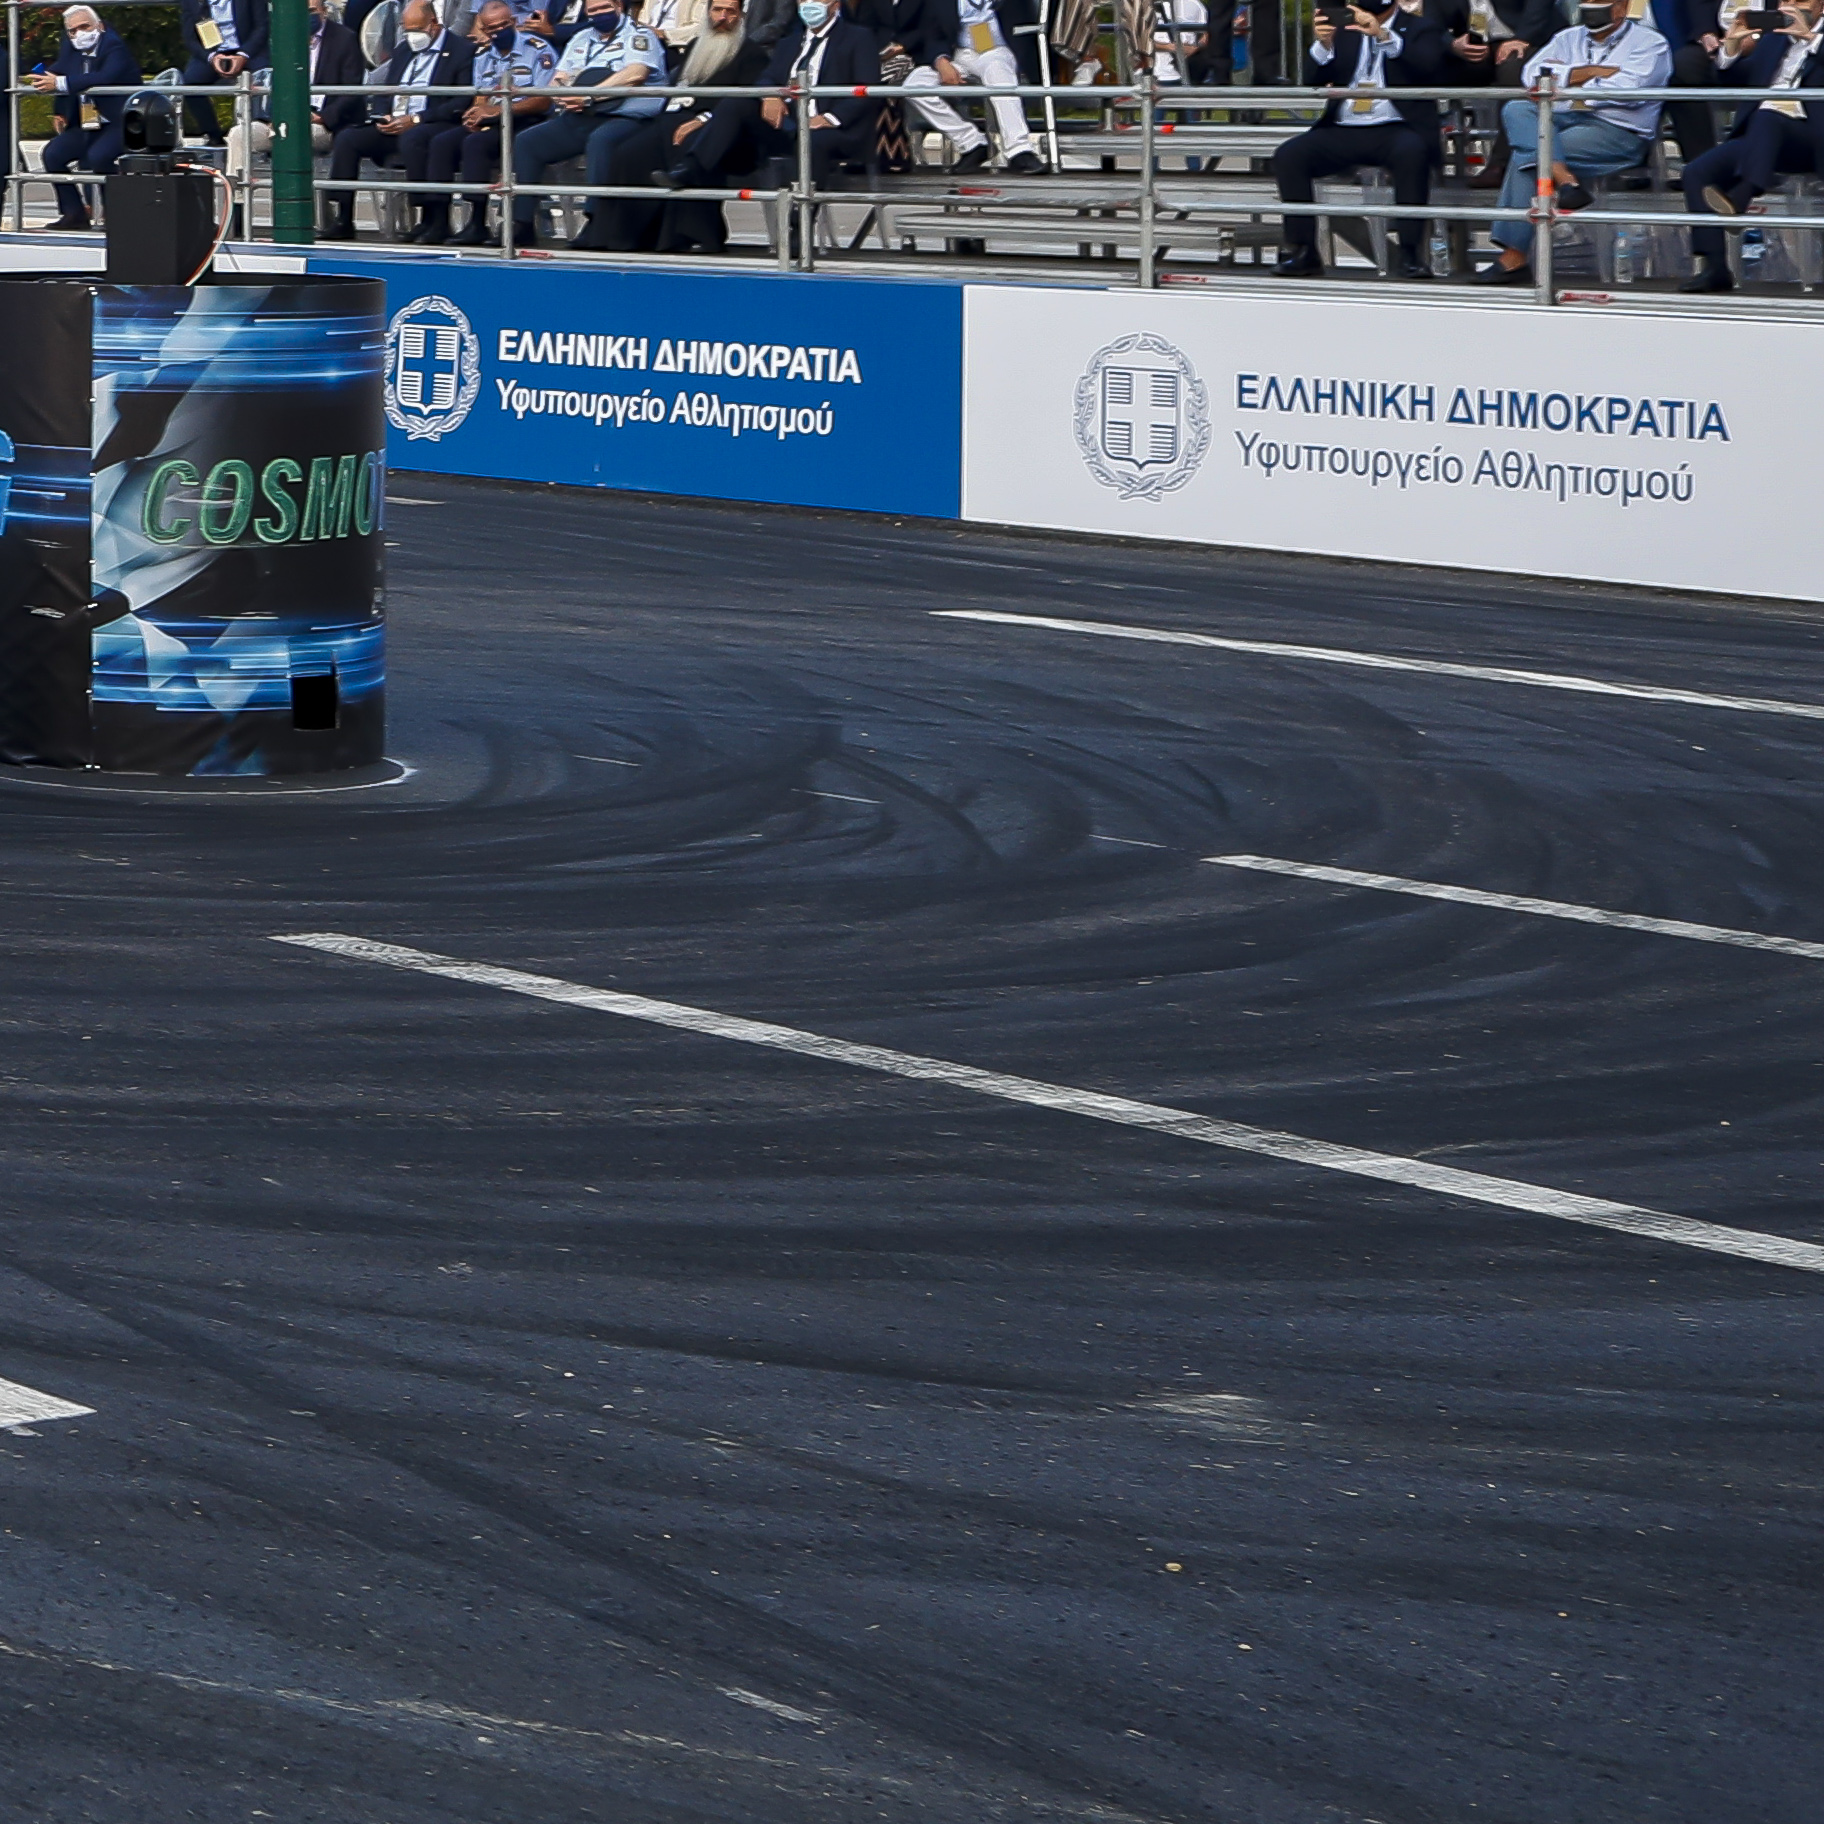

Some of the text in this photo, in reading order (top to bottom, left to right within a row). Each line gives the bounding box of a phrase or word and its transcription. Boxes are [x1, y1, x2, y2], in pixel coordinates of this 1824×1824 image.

[498, 329, 863, 384] ΕΛΛΗΝΙΚΗ ΔΗΜΟΚΡΑΤΙΑ
[496, 378, 834, 441] Υφυπουργείο Αθλητισμού
[1235, 373, 1731, 443] ΕΛΛΗΝΙΚΗ ΔΗΜΟΚΡΑΤΙΑ
[1234, 431, 1695, 507] Υφυπουργείο Αθλητισμού
